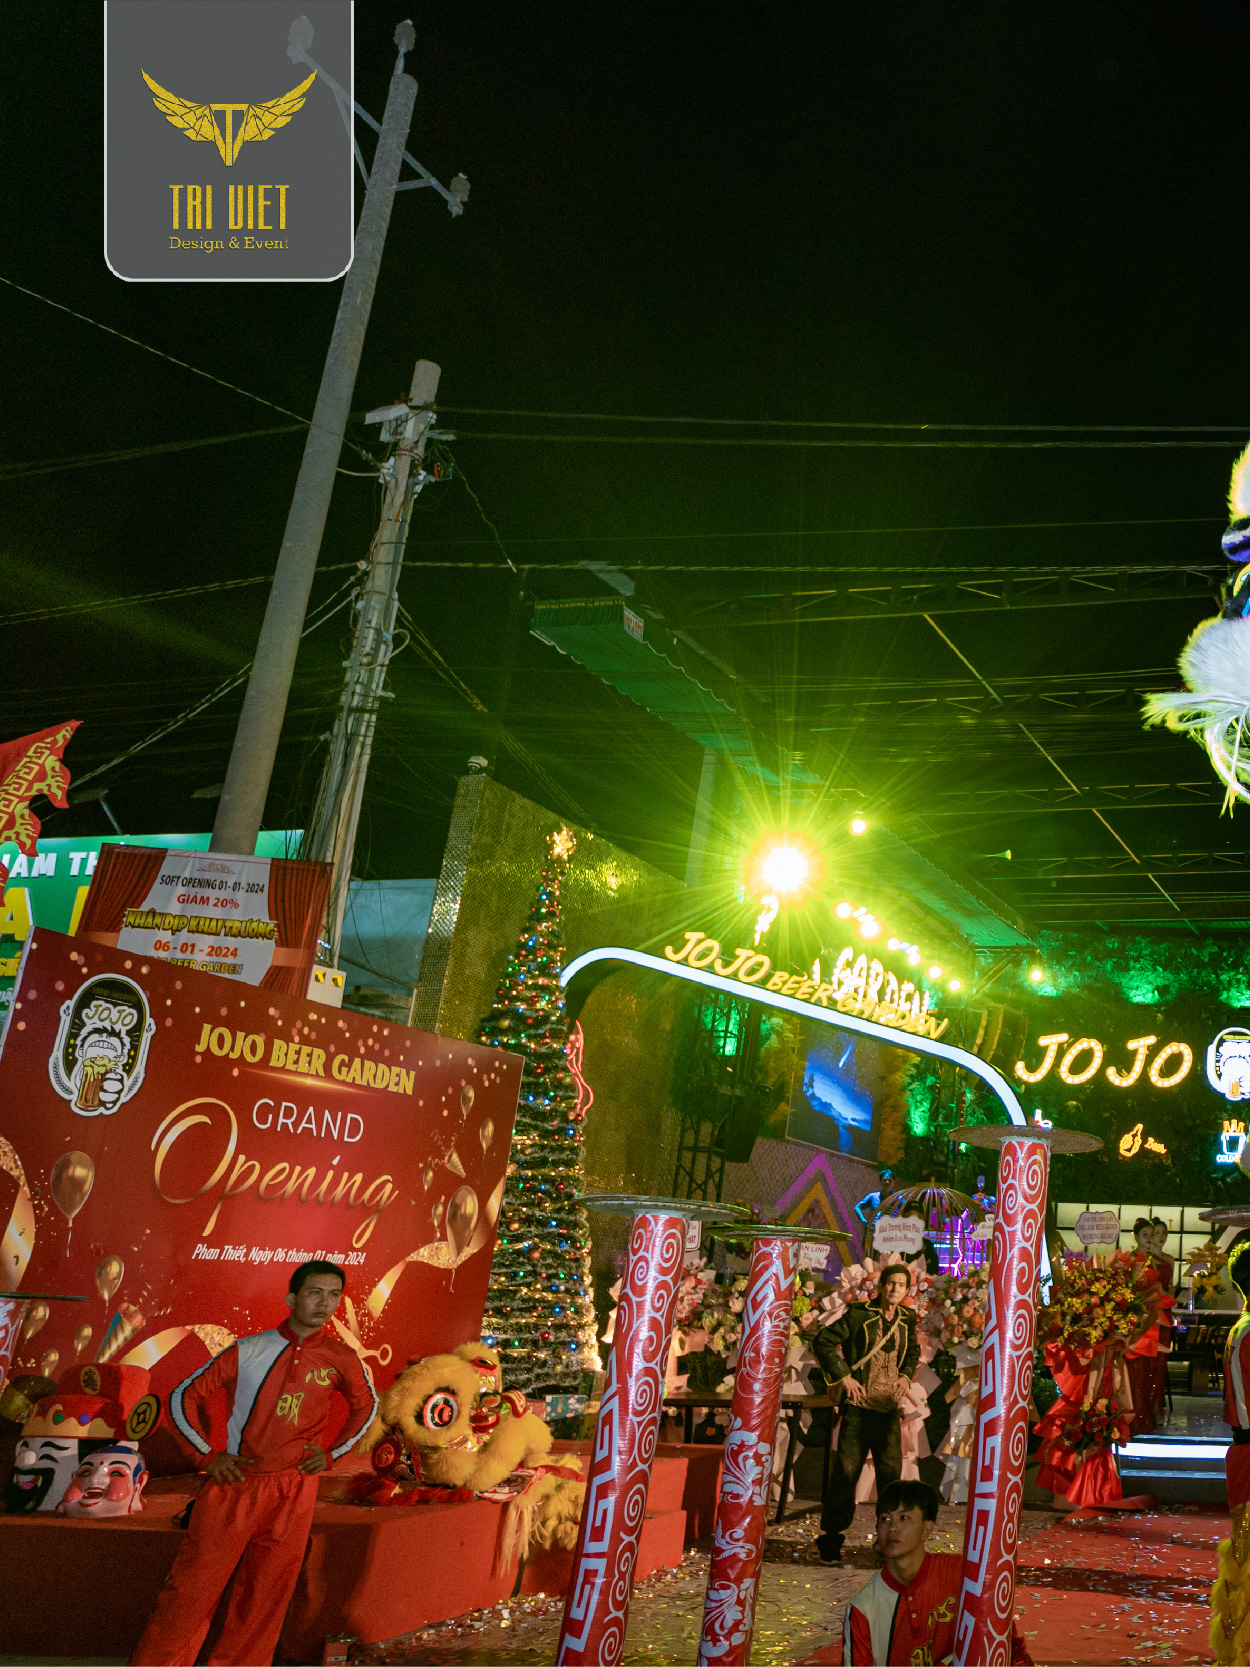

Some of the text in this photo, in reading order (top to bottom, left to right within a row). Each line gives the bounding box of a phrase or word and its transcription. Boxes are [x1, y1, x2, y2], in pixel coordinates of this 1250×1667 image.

[159, 874, 181, 887] SOFT
[181, 876, 217, 890] OPENING
[245, 883, 265, 894] 2024
[176, 891, 239, 909] GIẢM 20%
[124, 907, 162, 931] NHÂN
[161, 912, 189, 936] DỊP
[187, 915, 224, 937] KHAI
[153, 939, 171, 952] 06
[179, 942, 196, 955] 01
[205, 944, 239, 959] 2024
[198, 960, 244, 975] GARDEN
[664, 931, 949, 1040] JOJO BEER GARDEN
[84, 1004, 135, 1027] JOJO
[195, 1023, 416, 1096] JOJO BEER GARDEN
[1014, 1032, 1193, 1088] JOJO
[252, 1098, 364, 1143] GRAND
[150, 1096, 399, 1249] Opening
[192, 1243, 220, 1261] Phan
[247, 1246, 274, 1266] Ngày
[273, 1247, 287, 1263] 06
[286, 1248, 313, 1263] tháng
[313, 1249, 325, 1262] 01
[325, 1250, 345, 1265] năm
[344, 1251, 367, 1266] 2024
